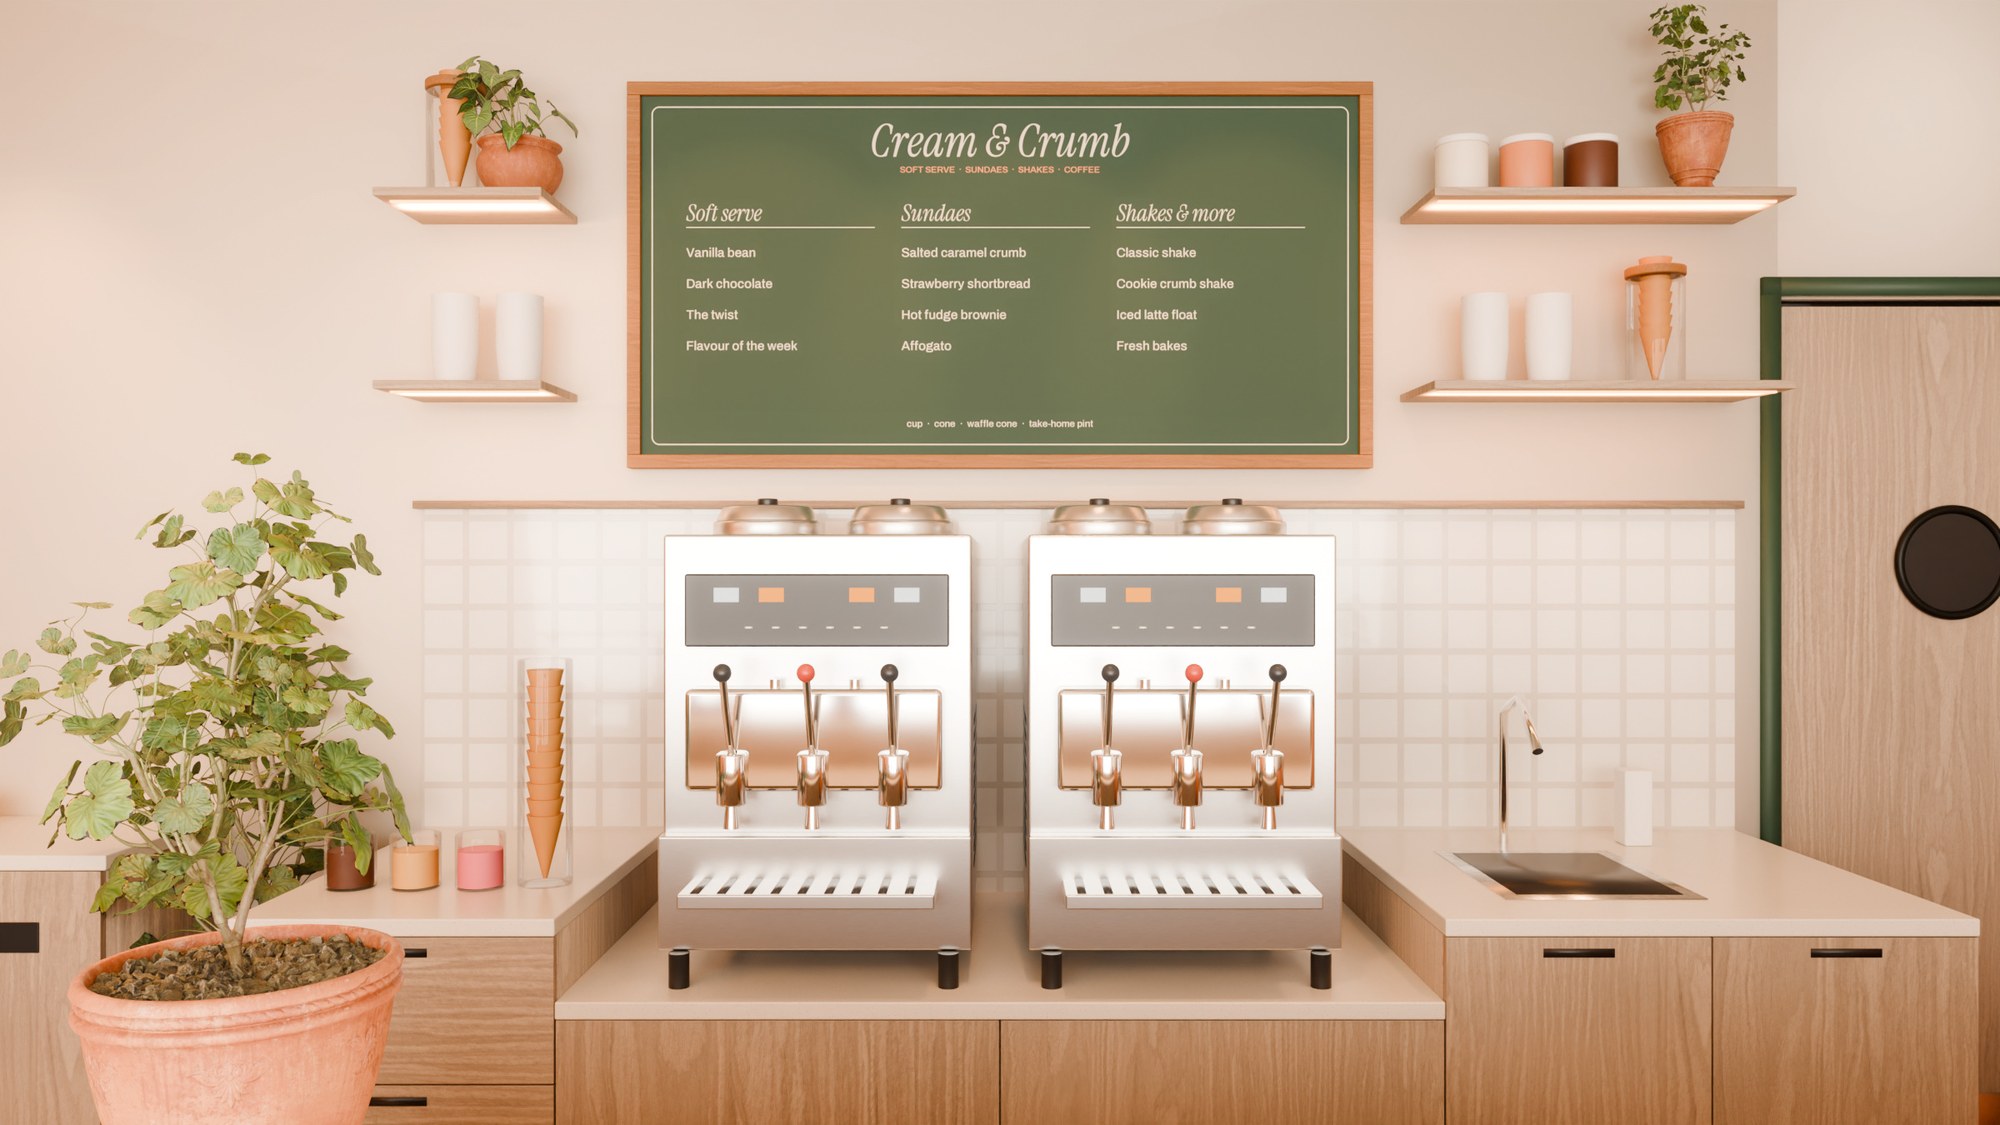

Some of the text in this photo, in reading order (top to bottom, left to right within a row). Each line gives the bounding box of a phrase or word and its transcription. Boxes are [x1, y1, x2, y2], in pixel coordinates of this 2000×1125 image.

[872, 123, 1130, 157] Cream & Crumb
[900, 165, 1100, 174] SOFT SERVE SUNDAES SHAKES COFFEE
[686, 203, 762, 222] Soft serve
[901, 204, 971, 222] Sundaes
[1116, 204, 1235, 222] Shakes & more
[686, 247, 756, 258] Vanilla bean
[901, 247, 1026, 258] Salted caramel crumb
[1117, 247, 1196, 258] Classic shake
[687, 278, 773, 289] Dark chocolate
[902, 278, 1030, 291] Strawberry shortbread
[1117, 278, 1234, 289] Cookie crumb shake
[686, 309, 738, 320] The twist
[902, 309, 1007, 322] Hot fudge brownie
[1117, 309, 1197, 320] Iced latte float
[687, 340, 797, 351] Flavour of the week
[901, 340, 952, 353] Affogato
[1117, 340, 1187, 351] Fresh bakes
[906, 419, 1093, 430] cup cone waffle cone take-home pint
